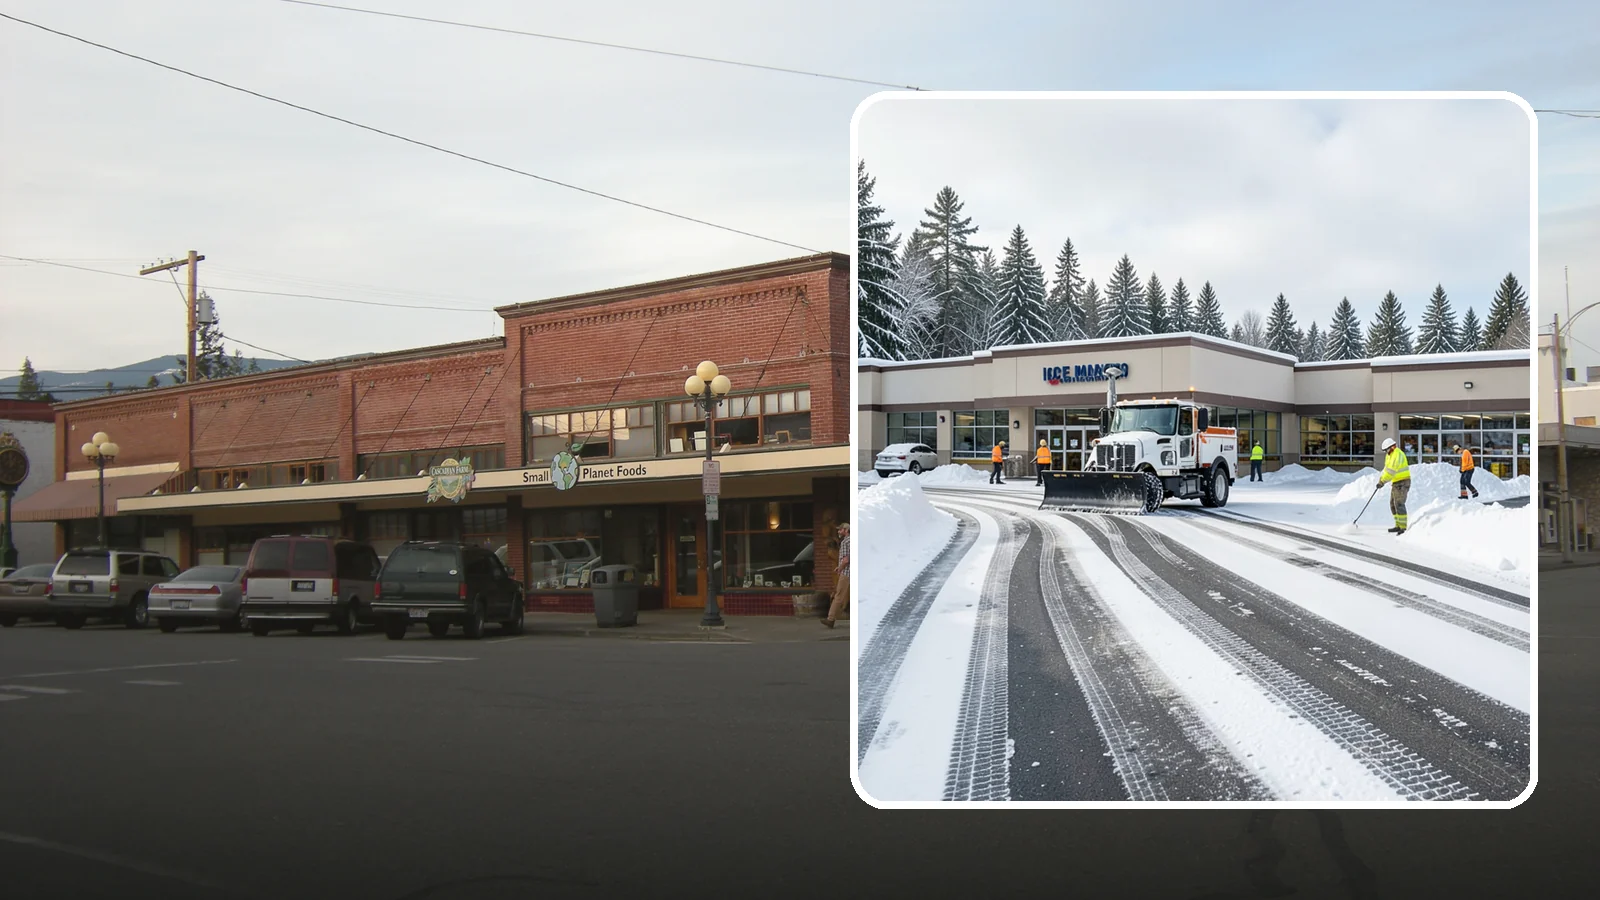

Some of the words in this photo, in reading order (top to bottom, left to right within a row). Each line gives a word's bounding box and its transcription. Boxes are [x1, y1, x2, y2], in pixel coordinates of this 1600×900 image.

[523, 471, 549, 483] Small
[583, 467, 614, 479] Planet
[617, 464, 647, 477] Foods
